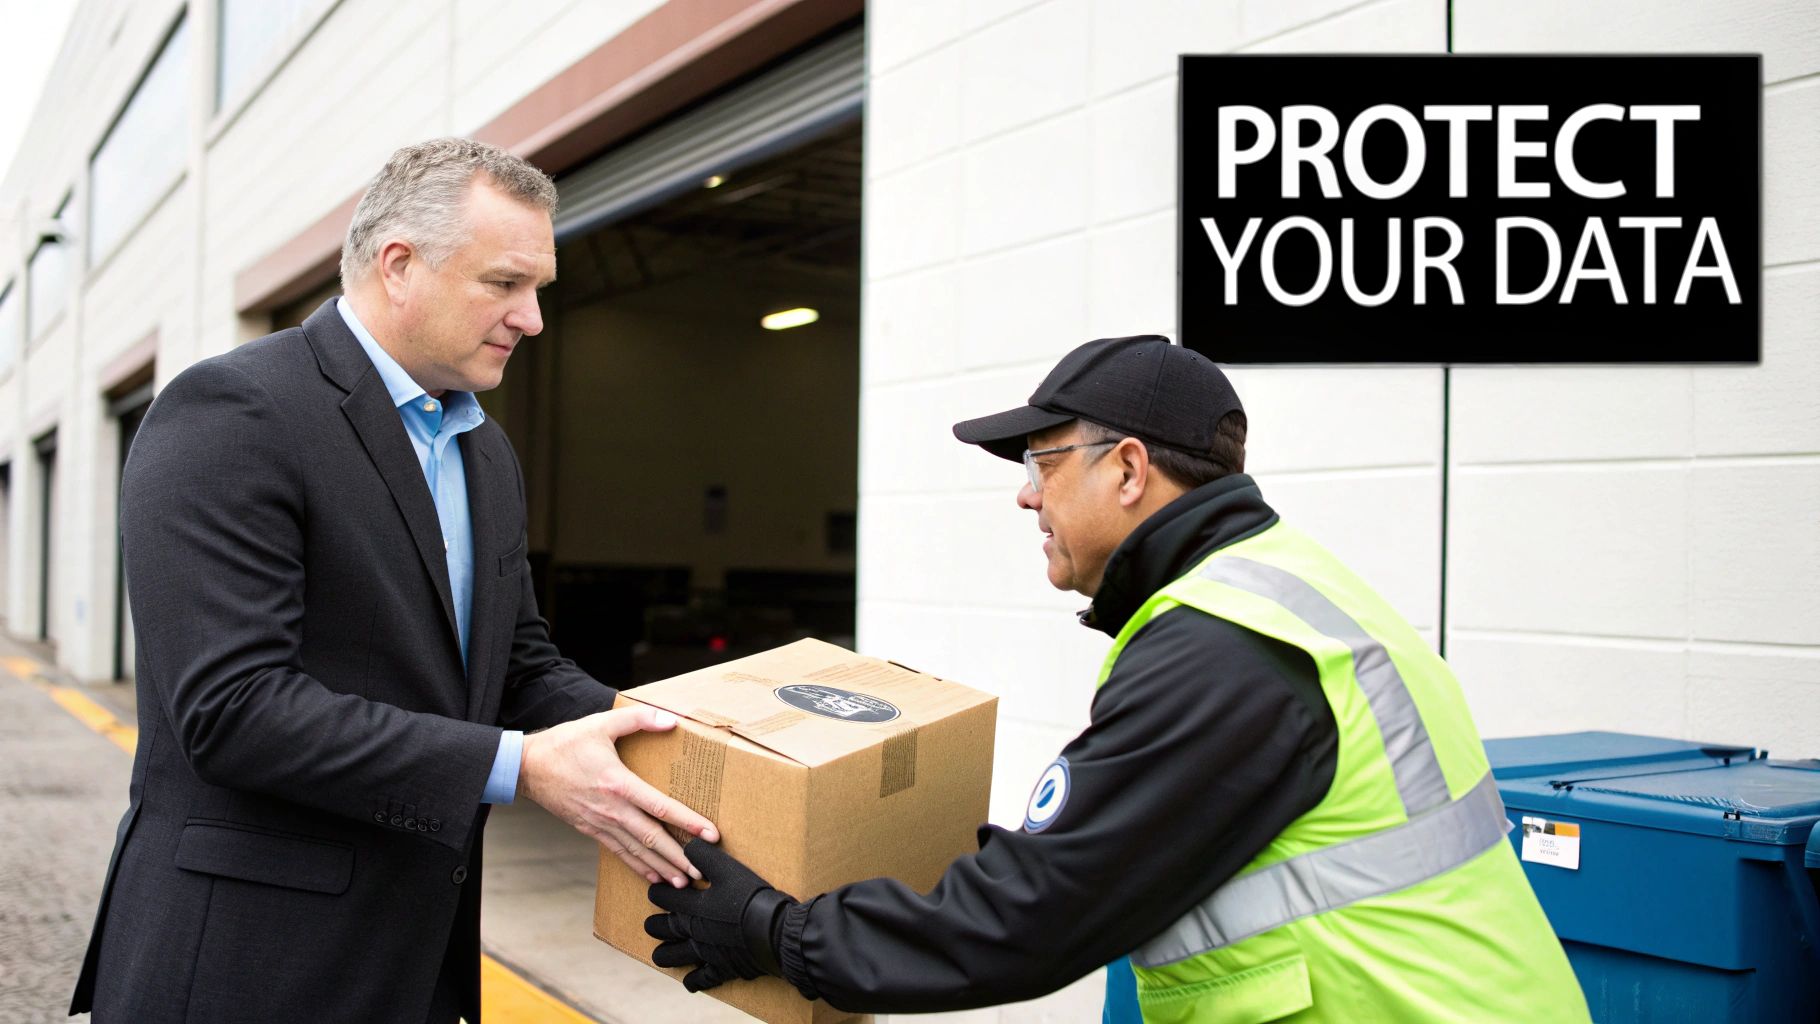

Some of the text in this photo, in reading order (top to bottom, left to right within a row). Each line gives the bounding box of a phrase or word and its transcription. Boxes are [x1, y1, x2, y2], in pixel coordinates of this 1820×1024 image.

[1217, 103, 1701, 199] PROTECT
[1200, 216, 1742, 306] YOUR DATA
